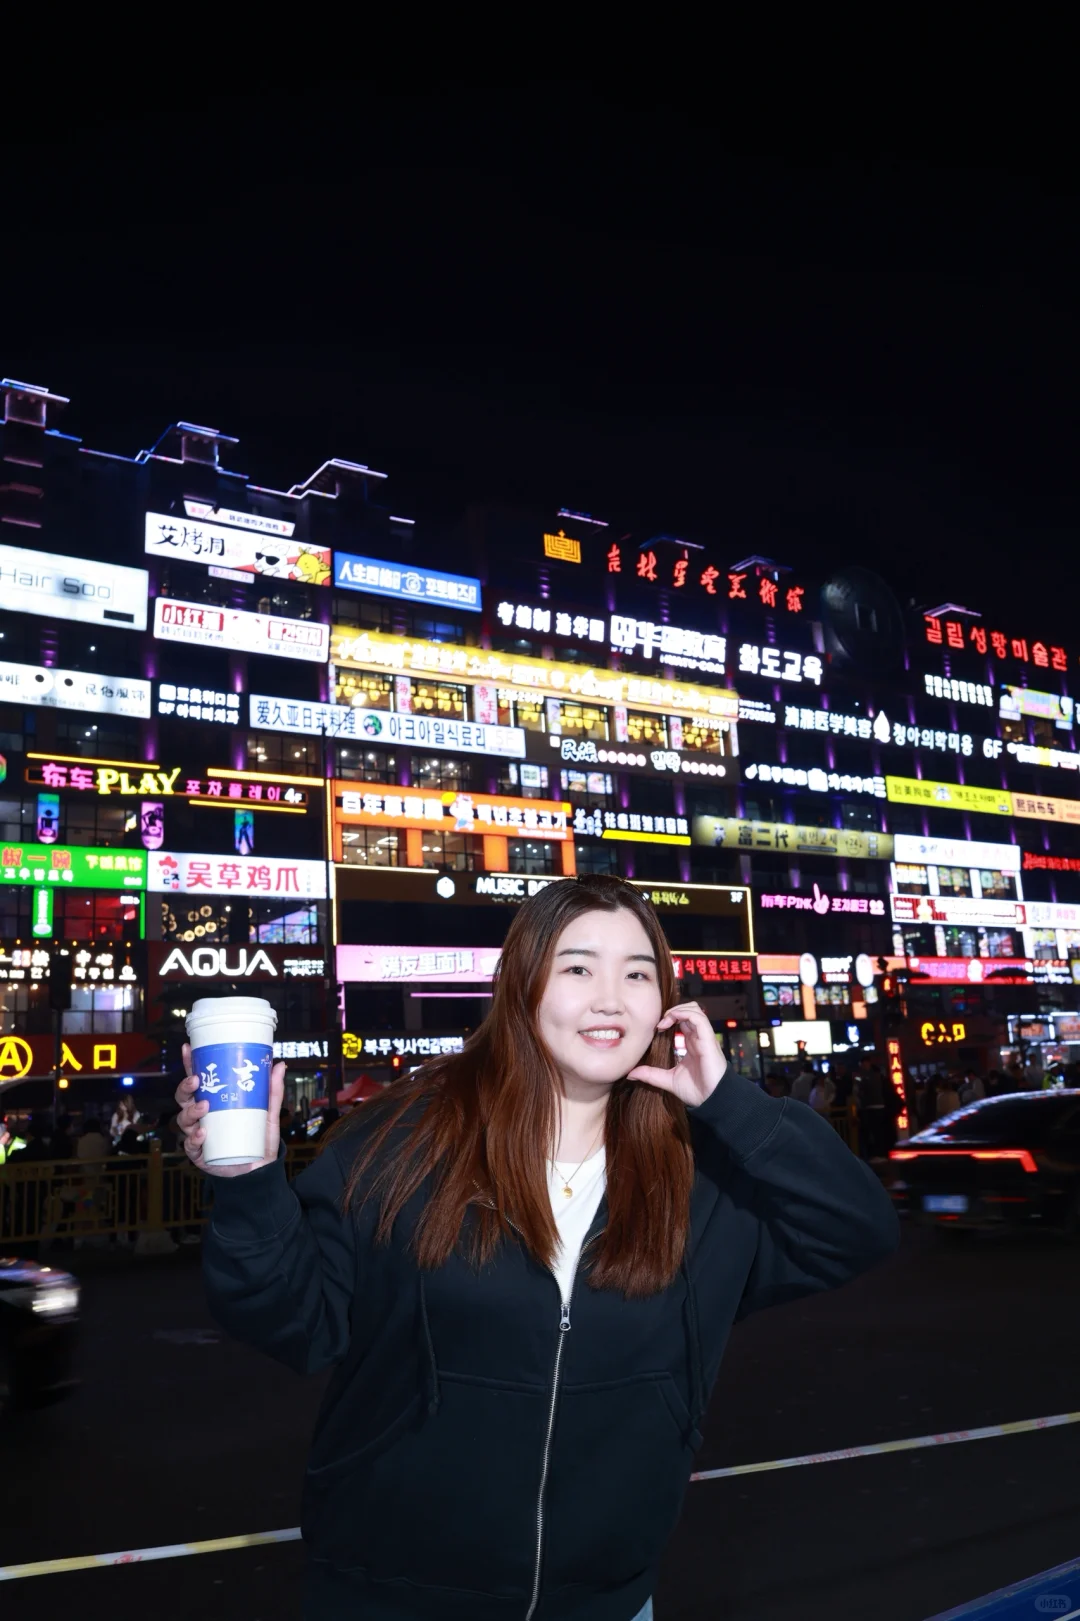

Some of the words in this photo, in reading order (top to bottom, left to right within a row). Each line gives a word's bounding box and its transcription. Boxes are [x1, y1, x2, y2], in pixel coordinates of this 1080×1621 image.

[0, 566, 52, 588] Hair
[63, 577, 111, 600] Soo
[738, 643, 824, 686] 화도교육
[256, 699, 356, 735] 爱久亚日式料理
[389, 717, 486, 750] 아크아일식료리
[983, 738, 1003, 759] 6F
[42, 763, 94, 789] 布车
[97, 767, 181, 795] PLAY
[737, 825, 790, 849] 富二代
[185, 861, 301, 893] 吴草鸡爪
[476, 876, 525, 896] MUSIC
[527, 880, 552, 897] BO
[787, 896, 812, 909] PINK
[158, 948, 278, 976] AQUA
[0, 1041, 24, 1072] A
[60, 1042, 117, 1071] 入口
[199, 1058, 260, 1094] 延吉
[220, 1092, 239, 1102] 연길
